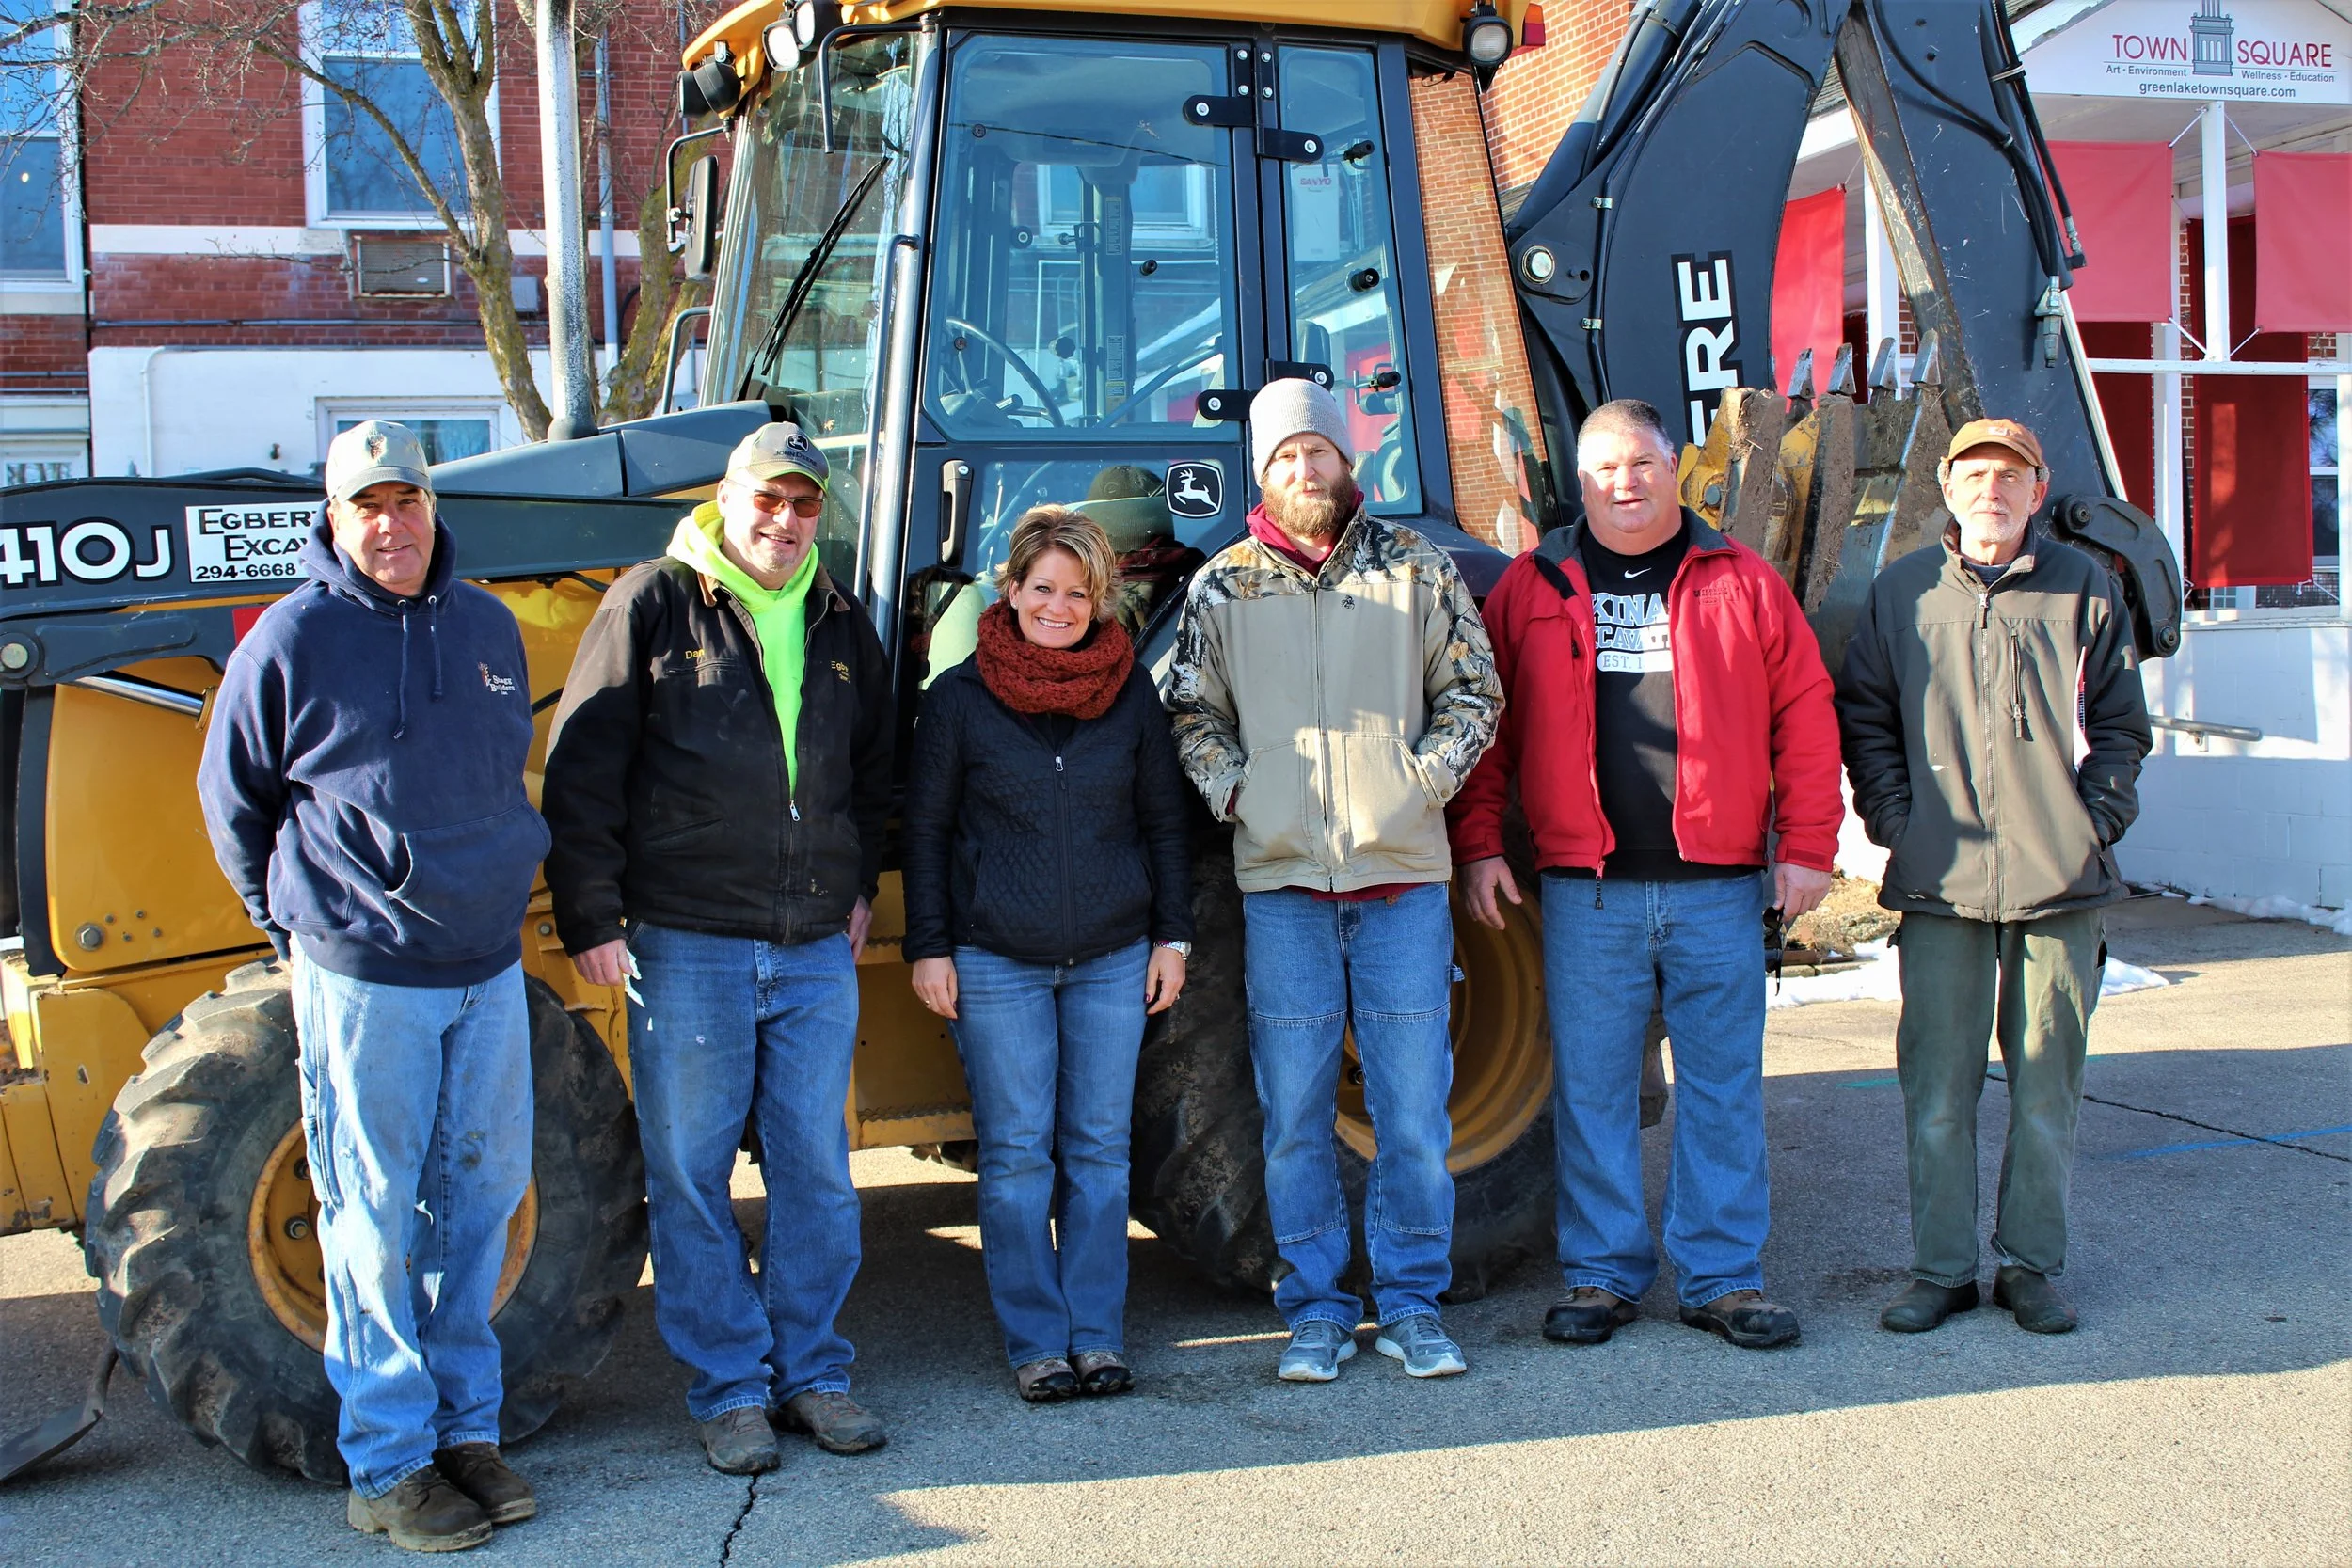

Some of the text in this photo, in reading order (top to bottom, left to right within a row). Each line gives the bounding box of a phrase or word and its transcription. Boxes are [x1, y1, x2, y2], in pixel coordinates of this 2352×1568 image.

[2112, 34, 2332, 67] TOWN SQUARE
[2106, 66, 2334, 83] Art Environment Wellness Education
[2138, 82, 2296, 98] greenlaketownsquare.com
[199, 509, 317, 535] EGBER
[0, 522, 171, 584] 410J
[224, 534, 308, 562] EXCA
[195, 563, 296, 579] 294-6668
[685, 648, 705, 659] Dan
[1603, 655, 1632, 669] EST.
